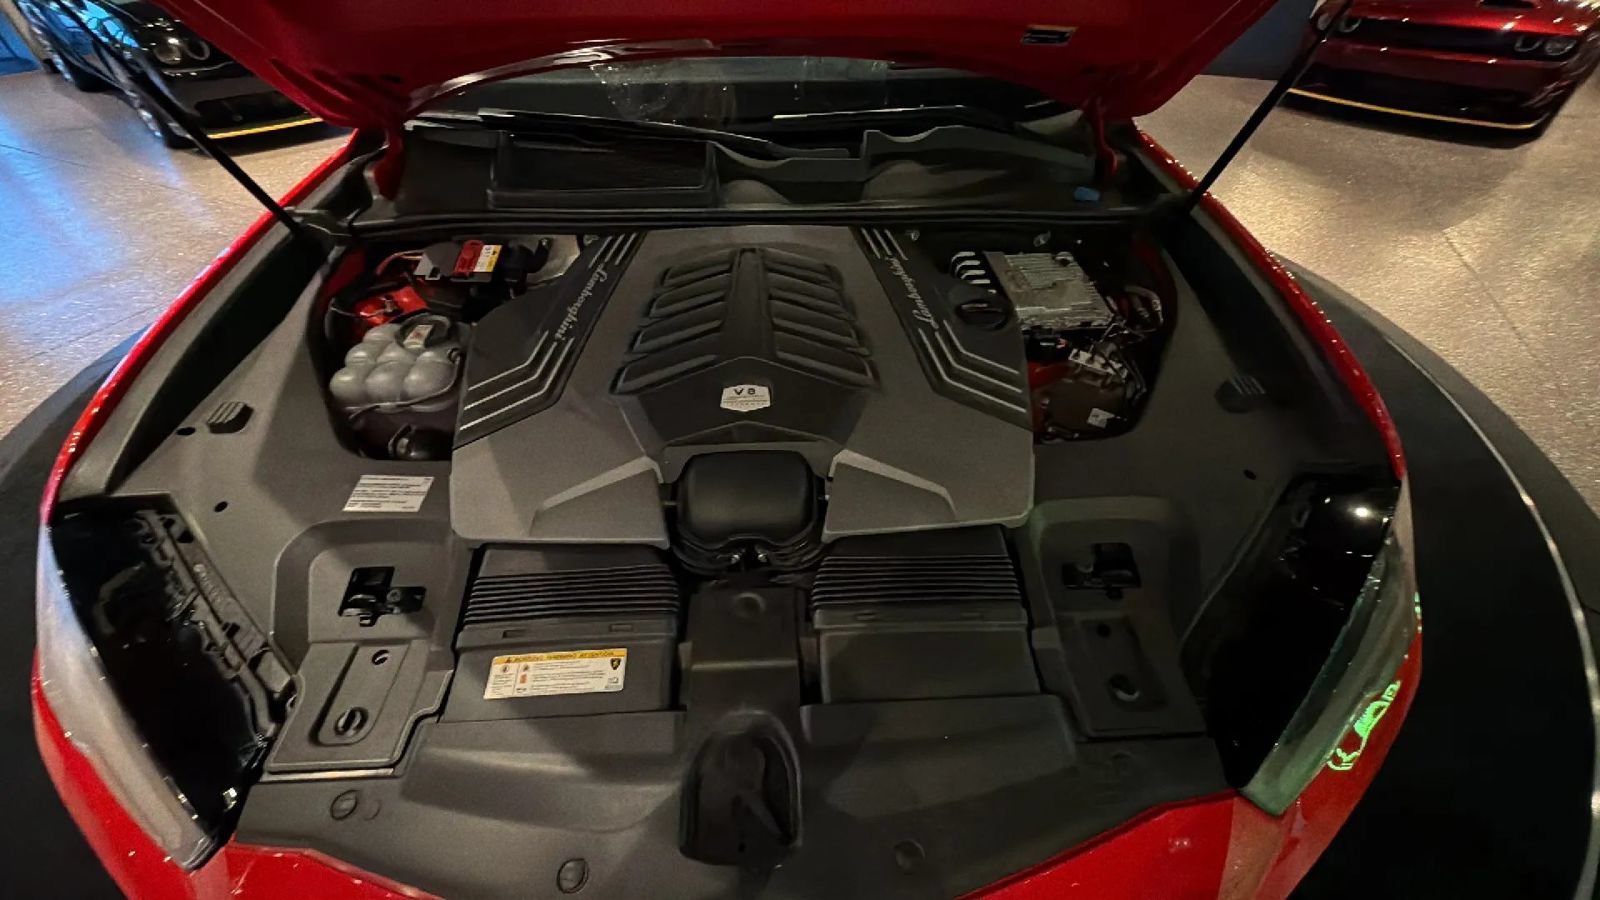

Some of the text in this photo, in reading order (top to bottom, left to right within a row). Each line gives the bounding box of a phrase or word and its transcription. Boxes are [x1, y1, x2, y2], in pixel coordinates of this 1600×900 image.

[554, 263, 608, 341] Lamborghini
[885, 256, 939, 329] Lamborghini
[733, 387, 756, 396] V8
